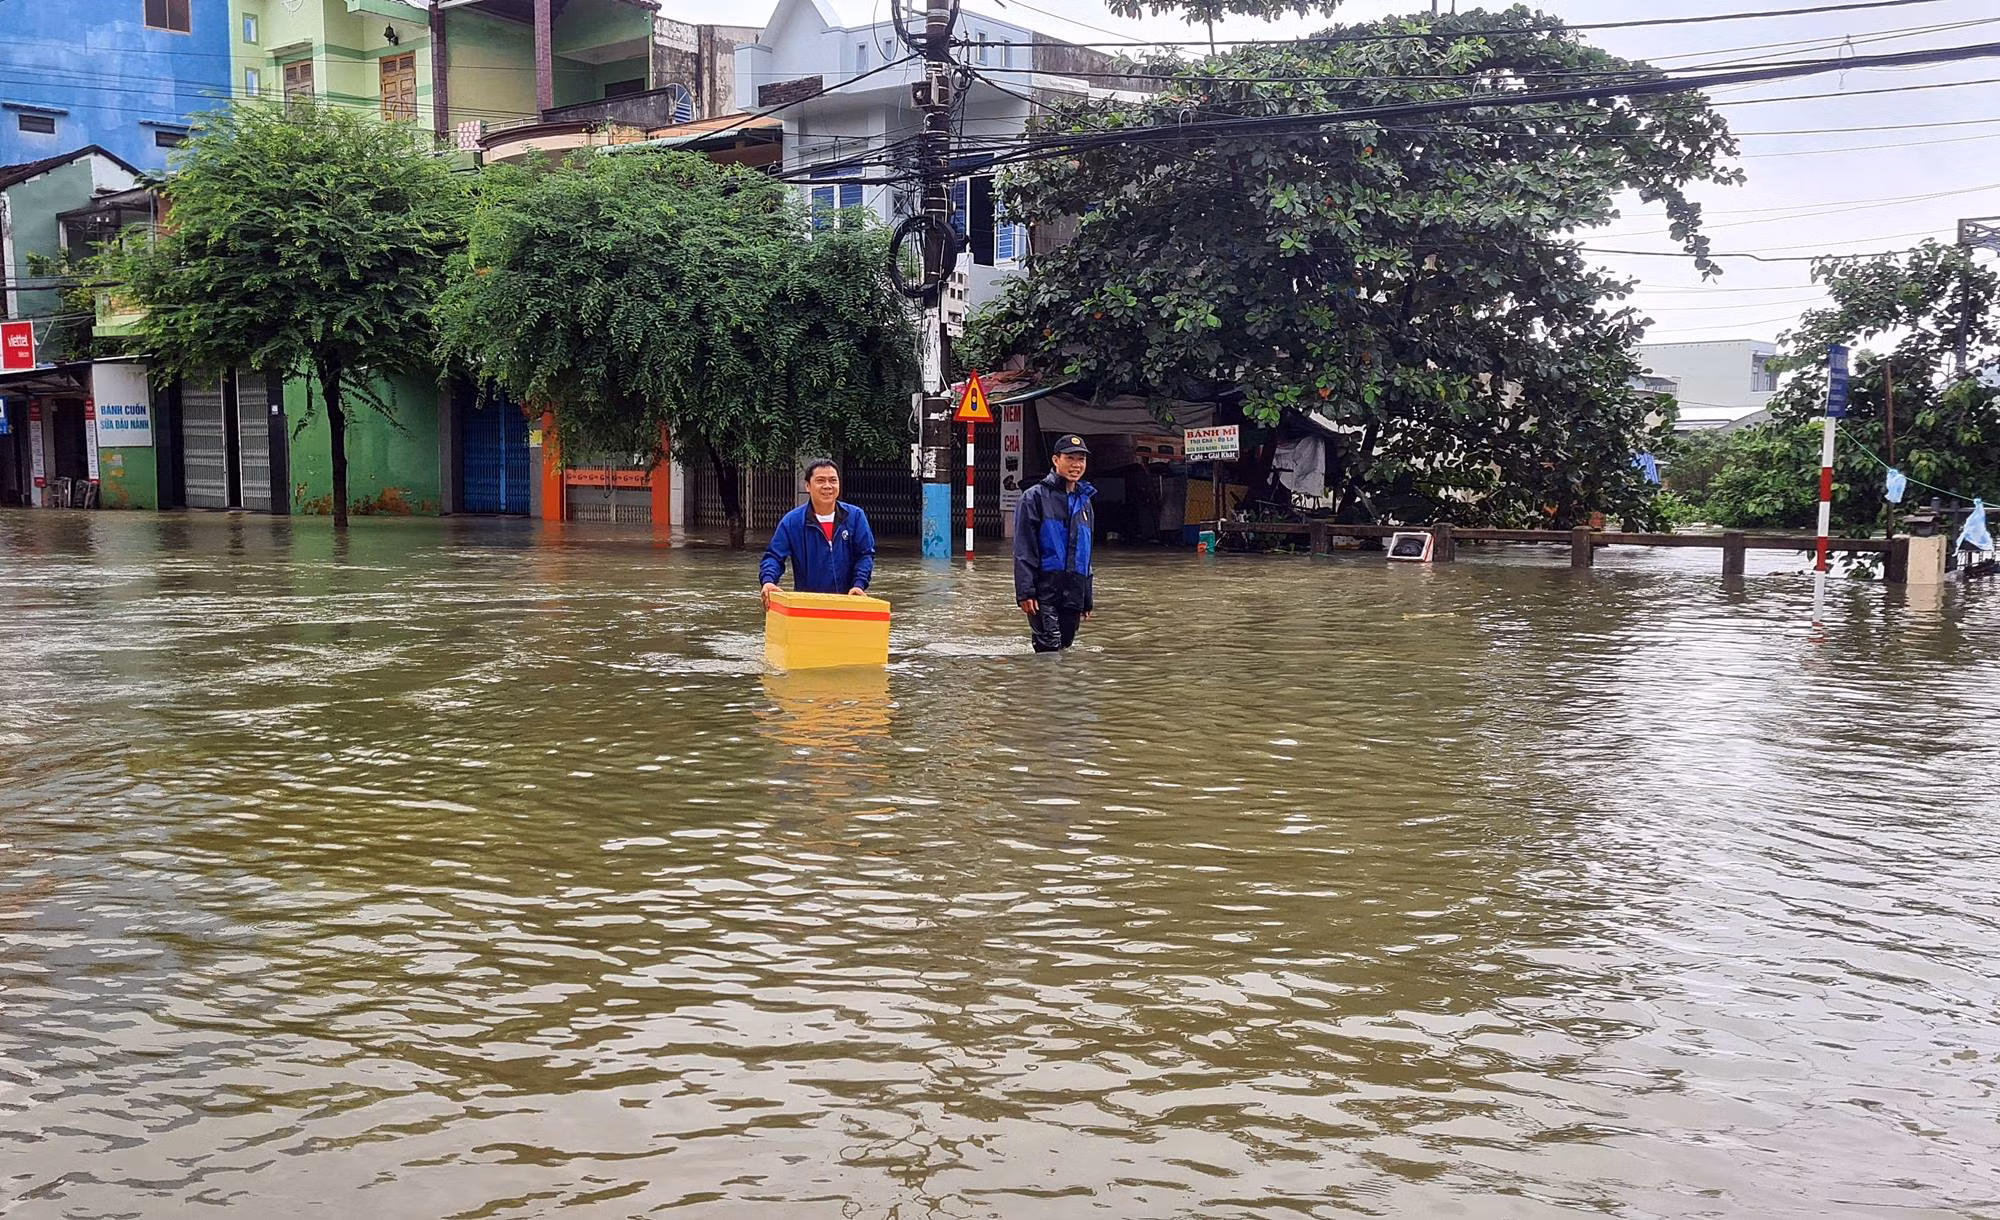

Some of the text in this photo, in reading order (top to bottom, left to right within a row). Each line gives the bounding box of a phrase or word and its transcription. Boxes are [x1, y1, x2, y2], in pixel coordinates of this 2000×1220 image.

[101, 403, 123, 415] BÁNH
[1003, 405, 1021, 422] NEM
[1187, 429, 1219, 438] BÁNH
